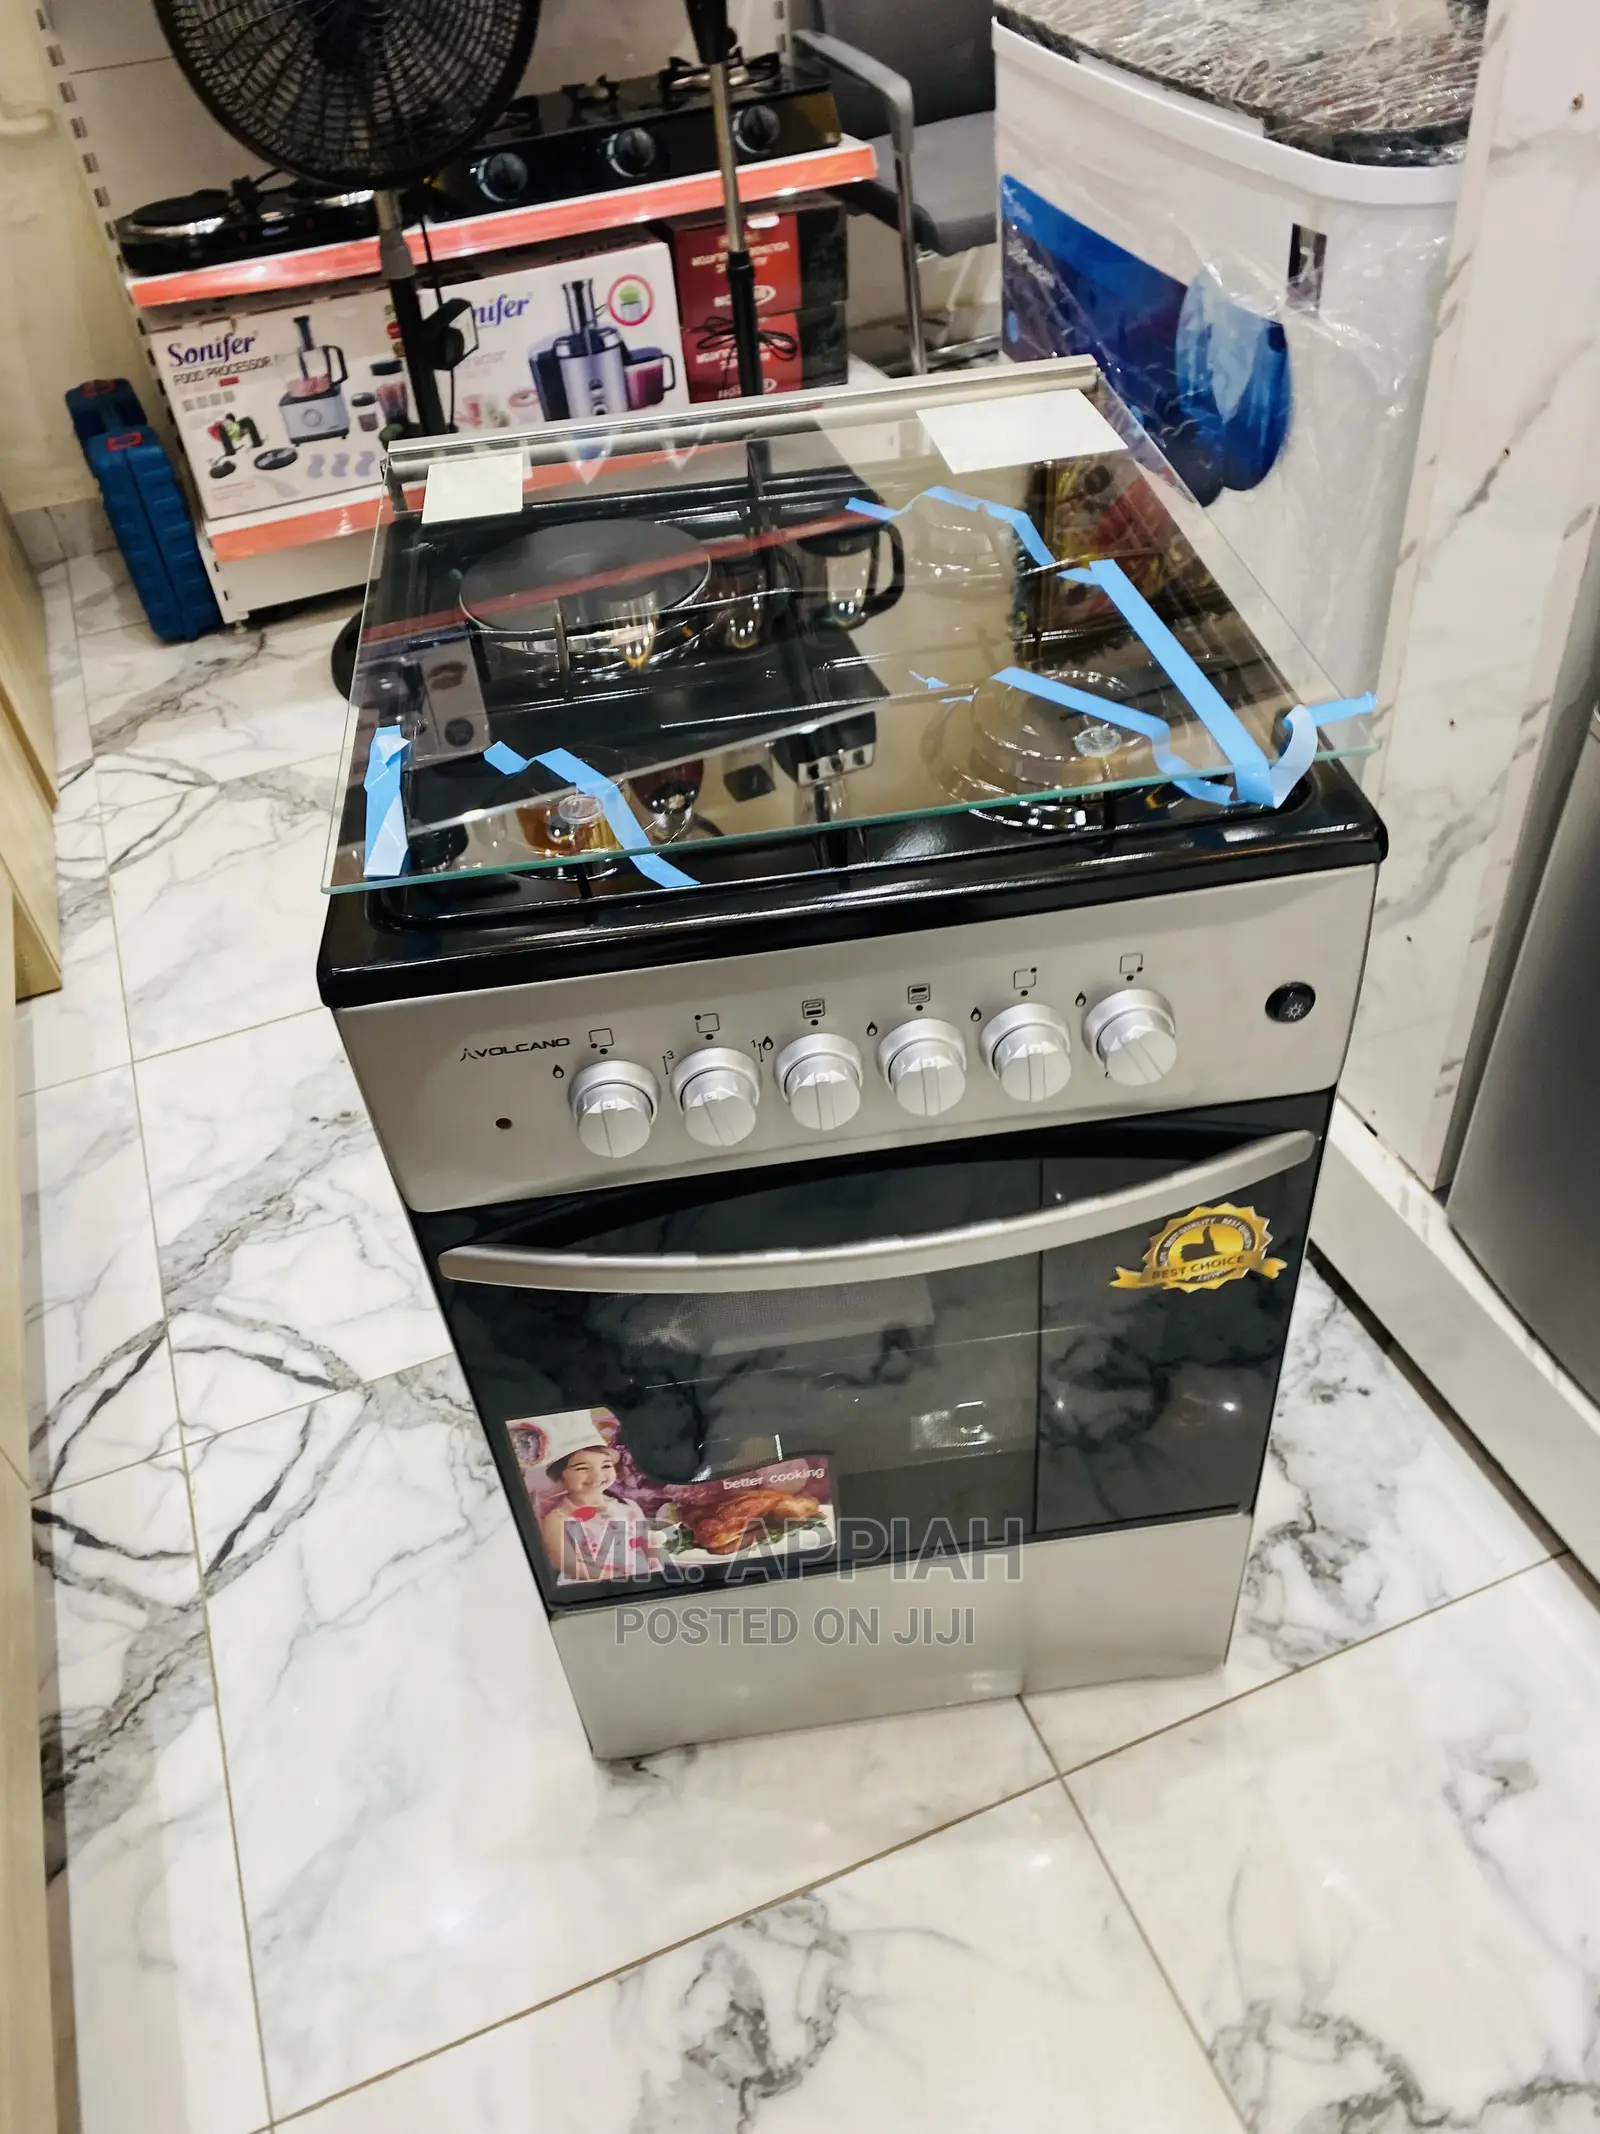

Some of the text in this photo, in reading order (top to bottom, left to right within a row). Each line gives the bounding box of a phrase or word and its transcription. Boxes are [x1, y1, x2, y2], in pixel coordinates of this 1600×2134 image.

[471, 293, 531, 327] nifer
[167, 332, 257, 368] Sonifer
[173, 370, 205, 387] FOOD
[205, 356, 272, 378] PROCESSOR
[474, 1037, 570, 1058] VOLCANO
[666, 1050, 675, 1060] 3
[1151, 1266, 1187, 1280] BEST
[1190, 1255, 1245, 1273] CHOICE
[722, 1467, 825, 1490] better cooking
